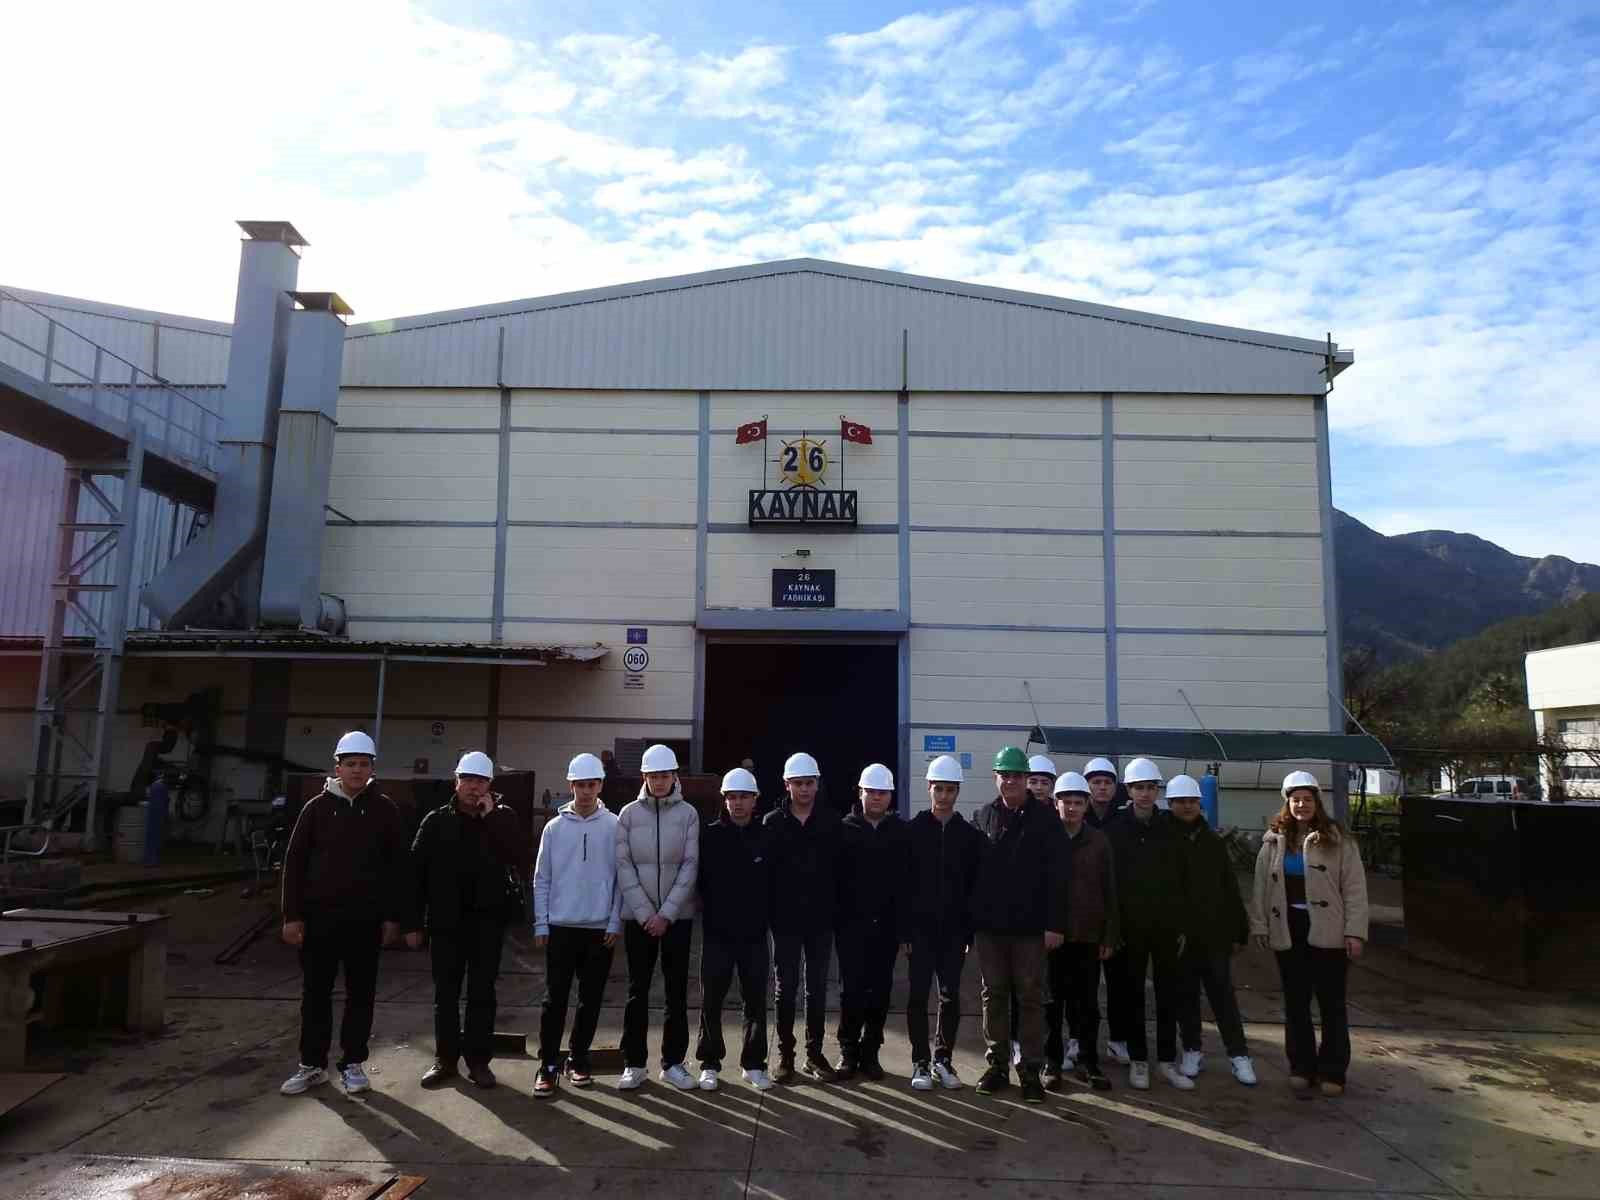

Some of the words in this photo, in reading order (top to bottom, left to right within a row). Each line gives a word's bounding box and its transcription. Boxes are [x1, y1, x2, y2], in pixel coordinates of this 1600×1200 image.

[783, 446, 823, 472] 26
[750, 491, 857, 521] KAYNAK
[797, 573, 810, 581] 26
[788, 583, 822, 592] KAYNAK
